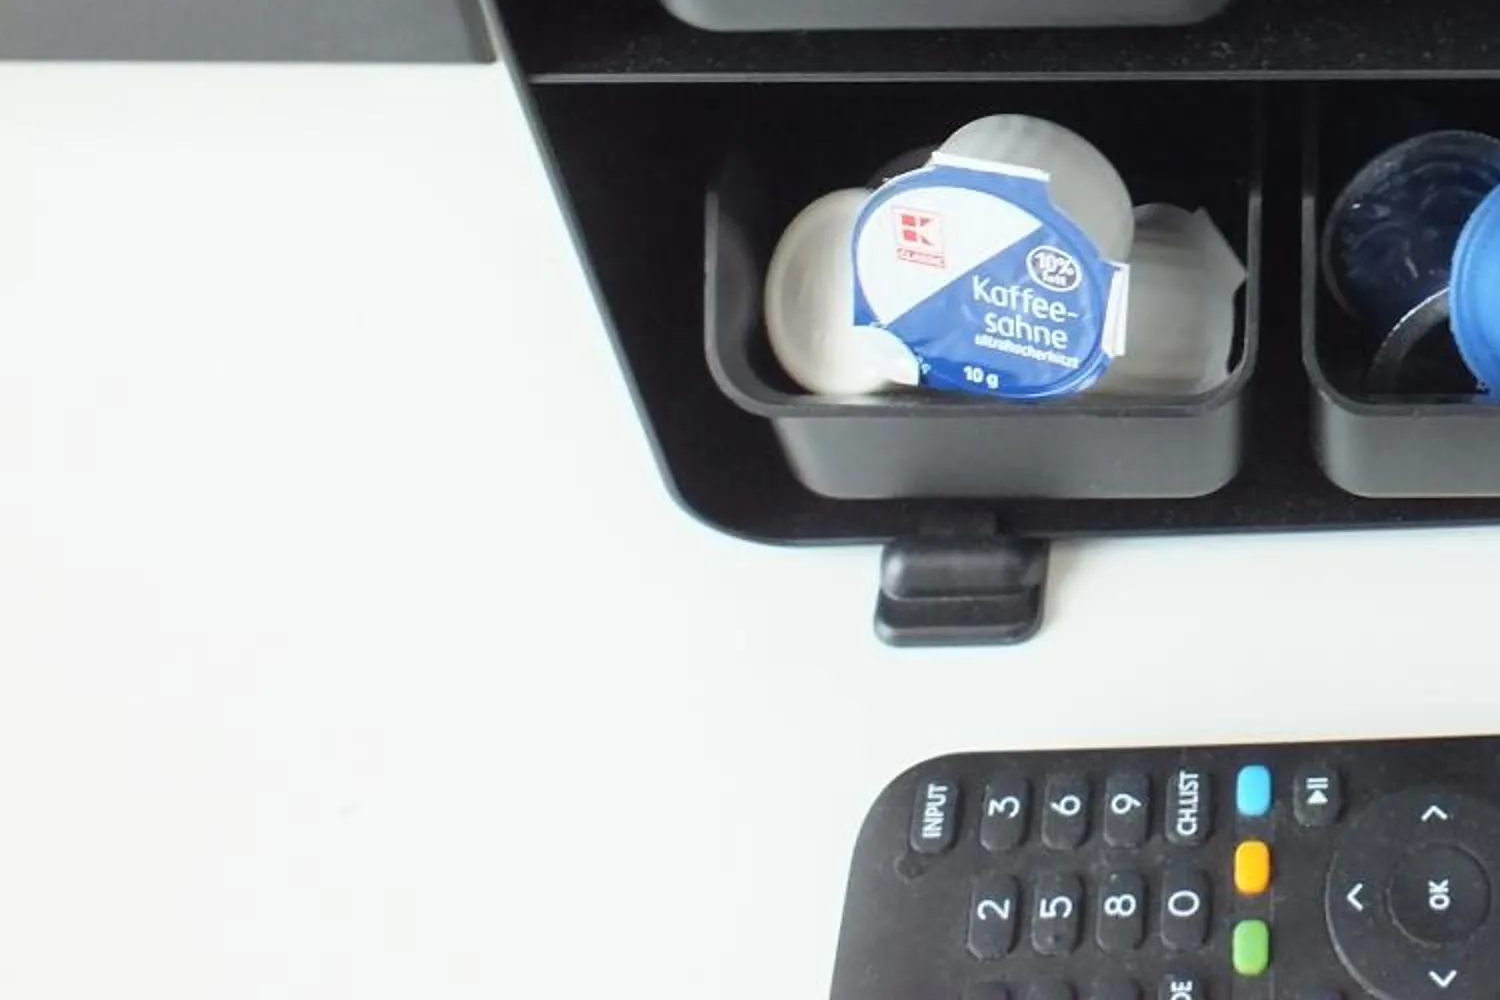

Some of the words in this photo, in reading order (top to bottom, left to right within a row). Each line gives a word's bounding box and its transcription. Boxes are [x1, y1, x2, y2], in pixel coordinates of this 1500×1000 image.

[1034, 251, 1075, 277] 10%
[971, 275, 1080, 323] Kaffee-
[984, 311, 1069, 350] sahne
[963, 365, 985, 384] 10
[985, 373, 1000, 390] g
[921, 782, 949, 839] INPUT
[987, 795, 1021, 819] 3
[1050, 794, 1082, 817] 6
[1110, 792, 1142, 815] 9
[1103, 893, 1137, 917] 8
[1428, 878, 1450, 911] OK
[977, 898, 1011, 921] 2
[1039, 896, 1073, 919] 5
